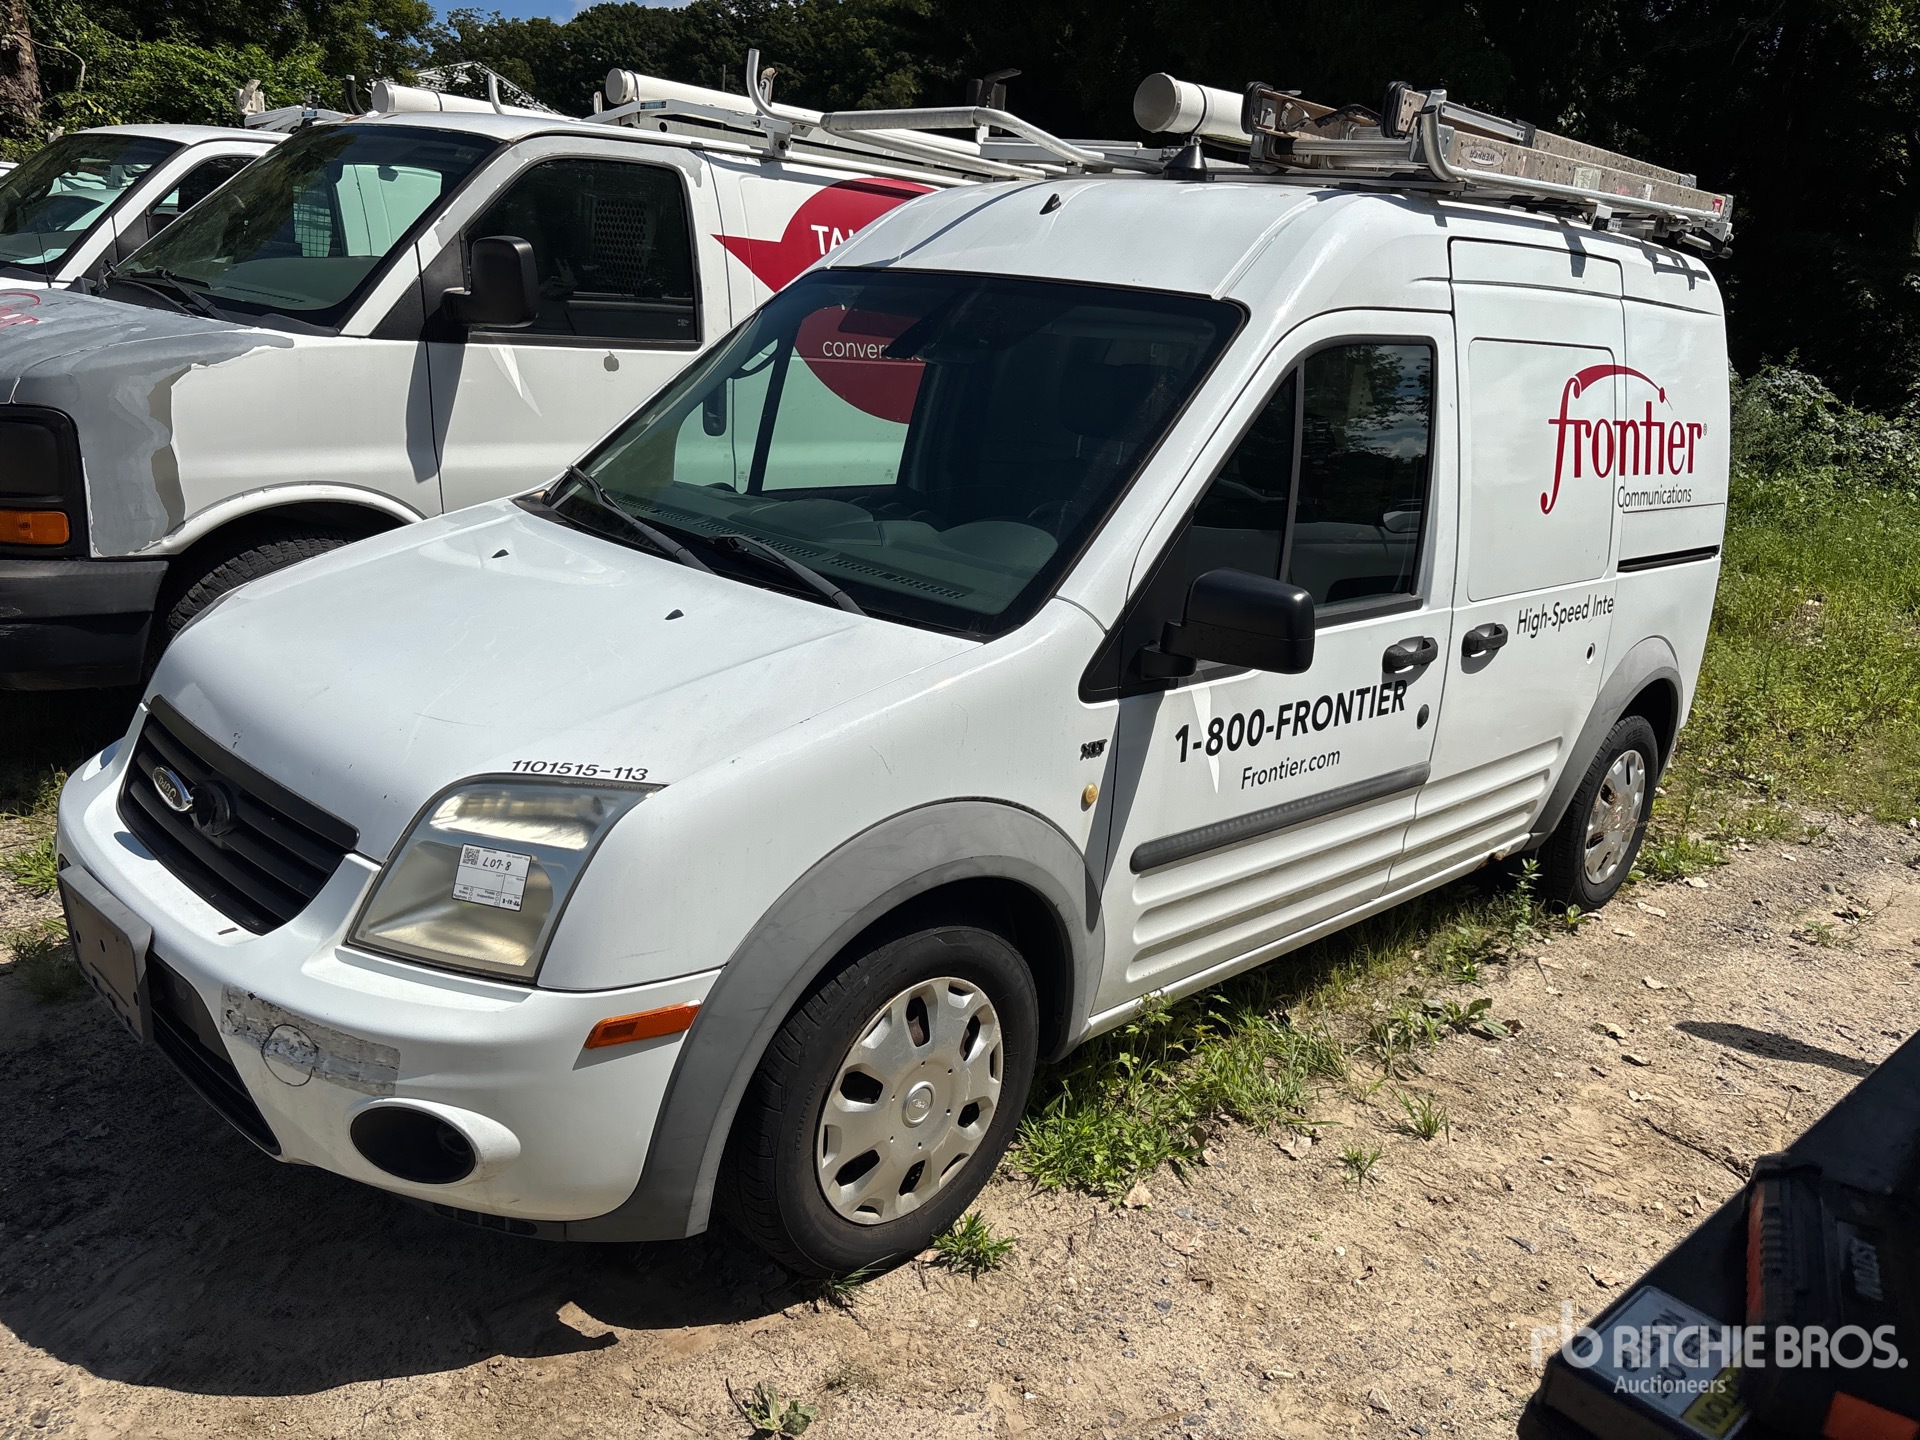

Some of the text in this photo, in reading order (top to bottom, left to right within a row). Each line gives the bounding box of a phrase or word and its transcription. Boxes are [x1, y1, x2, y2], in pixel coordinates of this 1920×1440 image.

[1468, 150, 1496, 163] WERNER
[811, 224, 854, 256] TA
[1540, 376, 1703, 515] frontier
[1617, 485, 1692, 508] Communications
[1517, 594, 1614, 638] High-Speed Inte
[1174, 679, 1407, 763] 1-800-FRONTIER
[1080, 739, 1107, 761] XLT
[512, 760, 649, 781] 1101515-113
[1240, 750, 1340, 790] Frontier.com
